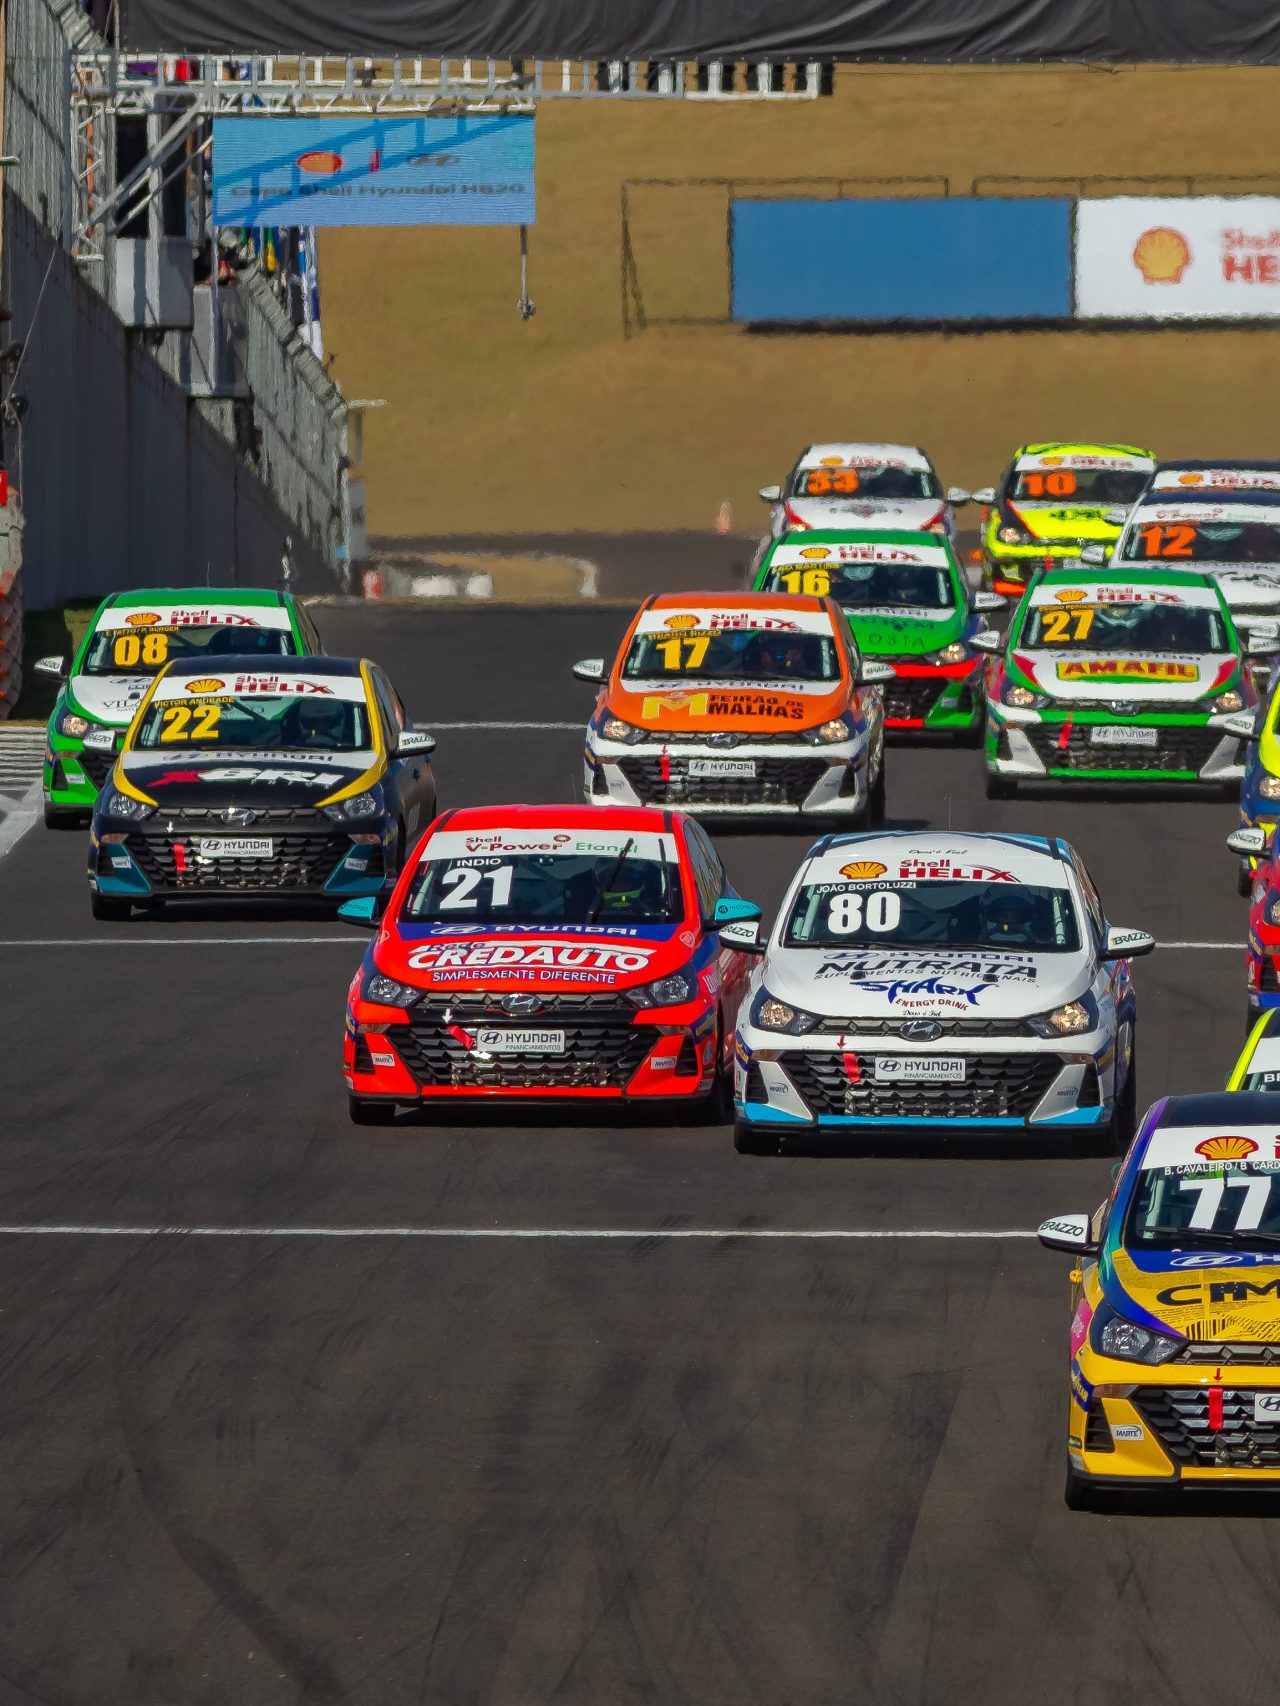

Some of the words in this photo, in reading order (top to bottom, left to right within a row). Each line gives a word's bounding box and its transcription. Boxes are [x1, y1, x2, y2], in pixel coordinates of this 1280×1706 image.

[1022, 470, 1078, 498] 10
[1139, 525, 1198, 557] 12
[780, 568, 831, 598] 16
[170, 613, 261, 627] HELIX
[709, 617, 804, 631] HELIX
[1041, 609, 1096, 643] 27
[113, 633, 169, 667] 08
[655, 636, 711, 670] 17
[1065, 660, 1196, 679] AMAFIL
[236, 675, 279, 684] Shell
[234, 681, 336, 695] HELIX
[708, 703, 804, 720] MALHAS
[159, 704, 221, 743] 22
[222, 841, 271, 850] HYUNDAI
[466, 835, 502, 844] Shell
[466, 842, 563, 853] V-Power
[456, 857, 502, 867] INDIO
[901, 858, 951, 868] Shell
[899, 864, 1021, 883] HELIX
[439, 865, 514, 910] 21
[816, 882, 846, 894] JOÃO
[848, 881, 917, 892] BORTOLUZZI
[827, 891, 901, 935] 80
[495, 925, 638, 936] HYUNDAI
[407, 946, 650, 971] CREDAUTO
[889, 951, 1034, 964] HYUNDAI
[432, 969, 535, 982] SIMPLESMENTE
[540, 969, 616, 984] DIFERENTE
[814, 968, 925, 981] SUPLMENTOS
[930, 969, 1038, 984] NUTRICNAIS
[816, 959, 1038, 979] NUTRATA
[849, 976, 1000, 1007] SHARK
[895, 998, 936, 1008] ENERGY
[938, 998, 970, 1012] DRINK
[505, 1033, 562, 1044] HYUNDAI
[904, 1061, 964, 1072] HYUNDAI
[904, 1071, 964, 1079] FINANCIAMENTOS
[1176, 1161, 1233, 1175] CAVALEIRO
[1179, 1175, 1273, 1231] 77
[1040, 1221, 1084, 1236] BRAZZO
[1116, 1429, 1139, 1437] MARTE
